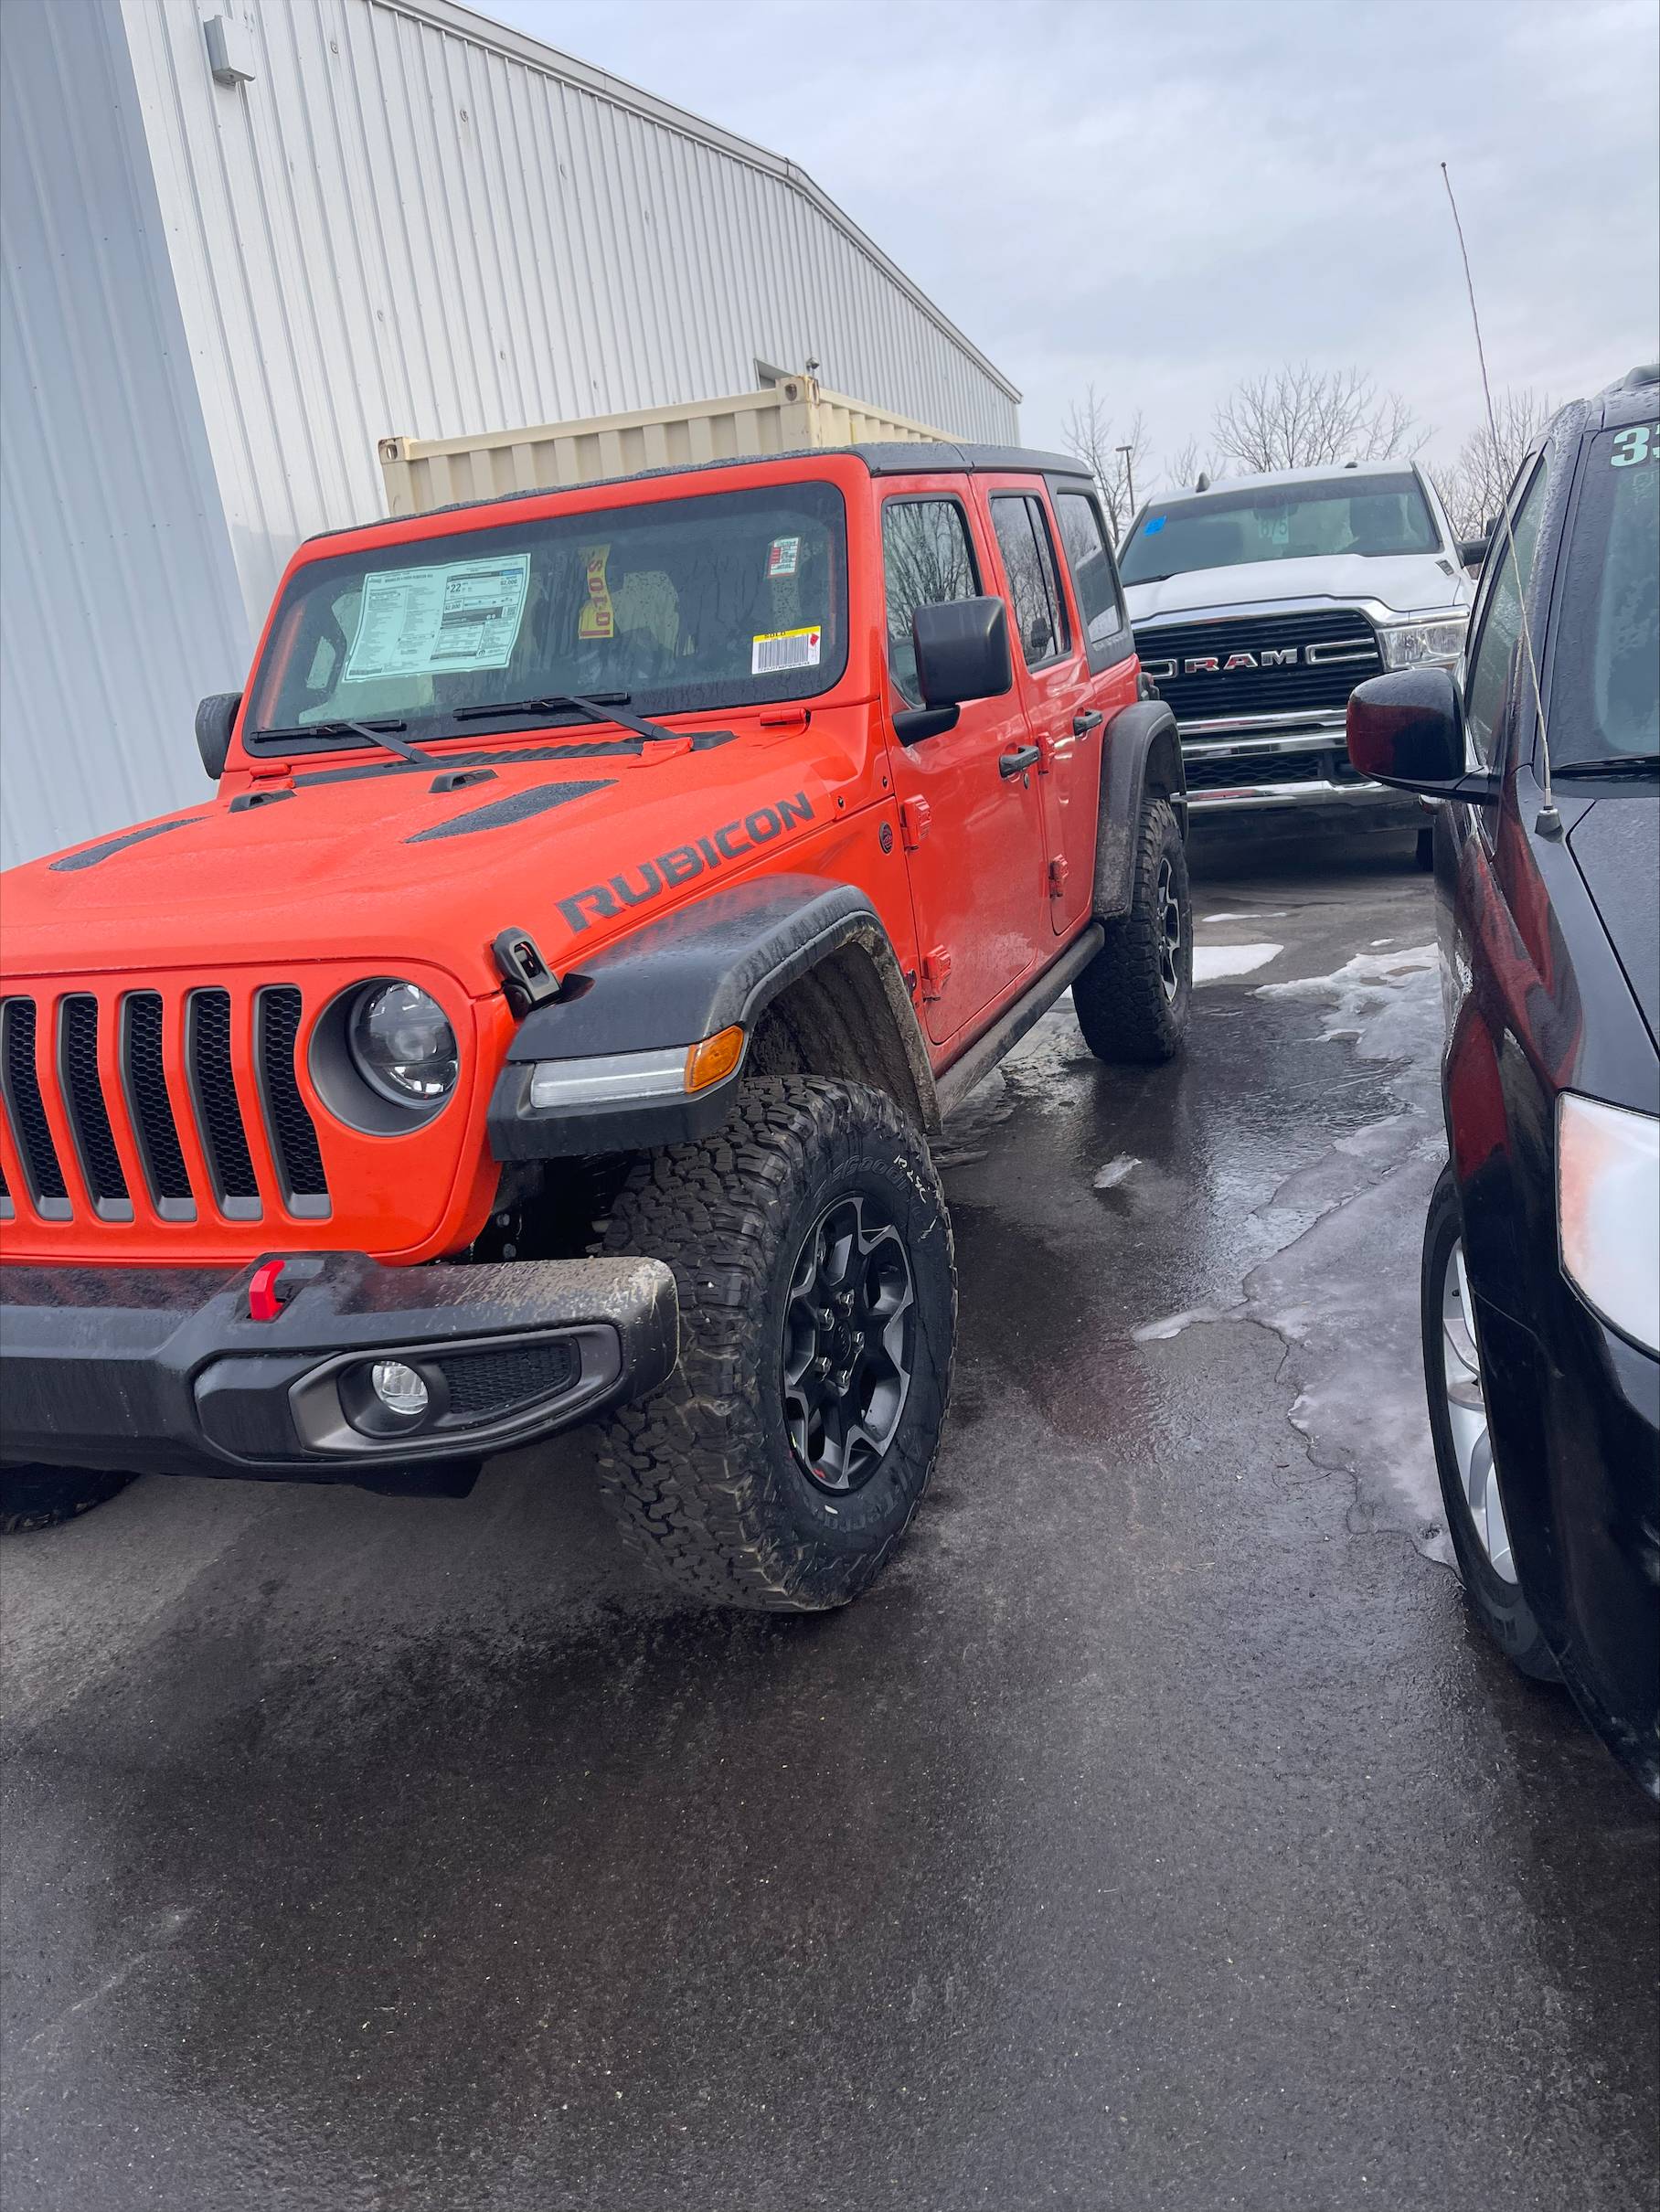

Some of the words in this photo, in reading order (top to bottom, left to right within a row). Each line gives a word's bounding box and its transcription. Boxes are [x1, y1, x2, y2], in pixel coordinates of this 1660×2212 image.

[1611, 425, 1660, 467] 3
[450, 583, 462, 593] 22
[588, 557, 611, 626] SOLD
[1185, 648, 1298, 675] RAM
[554, 792, 815, 932] RUBICON
